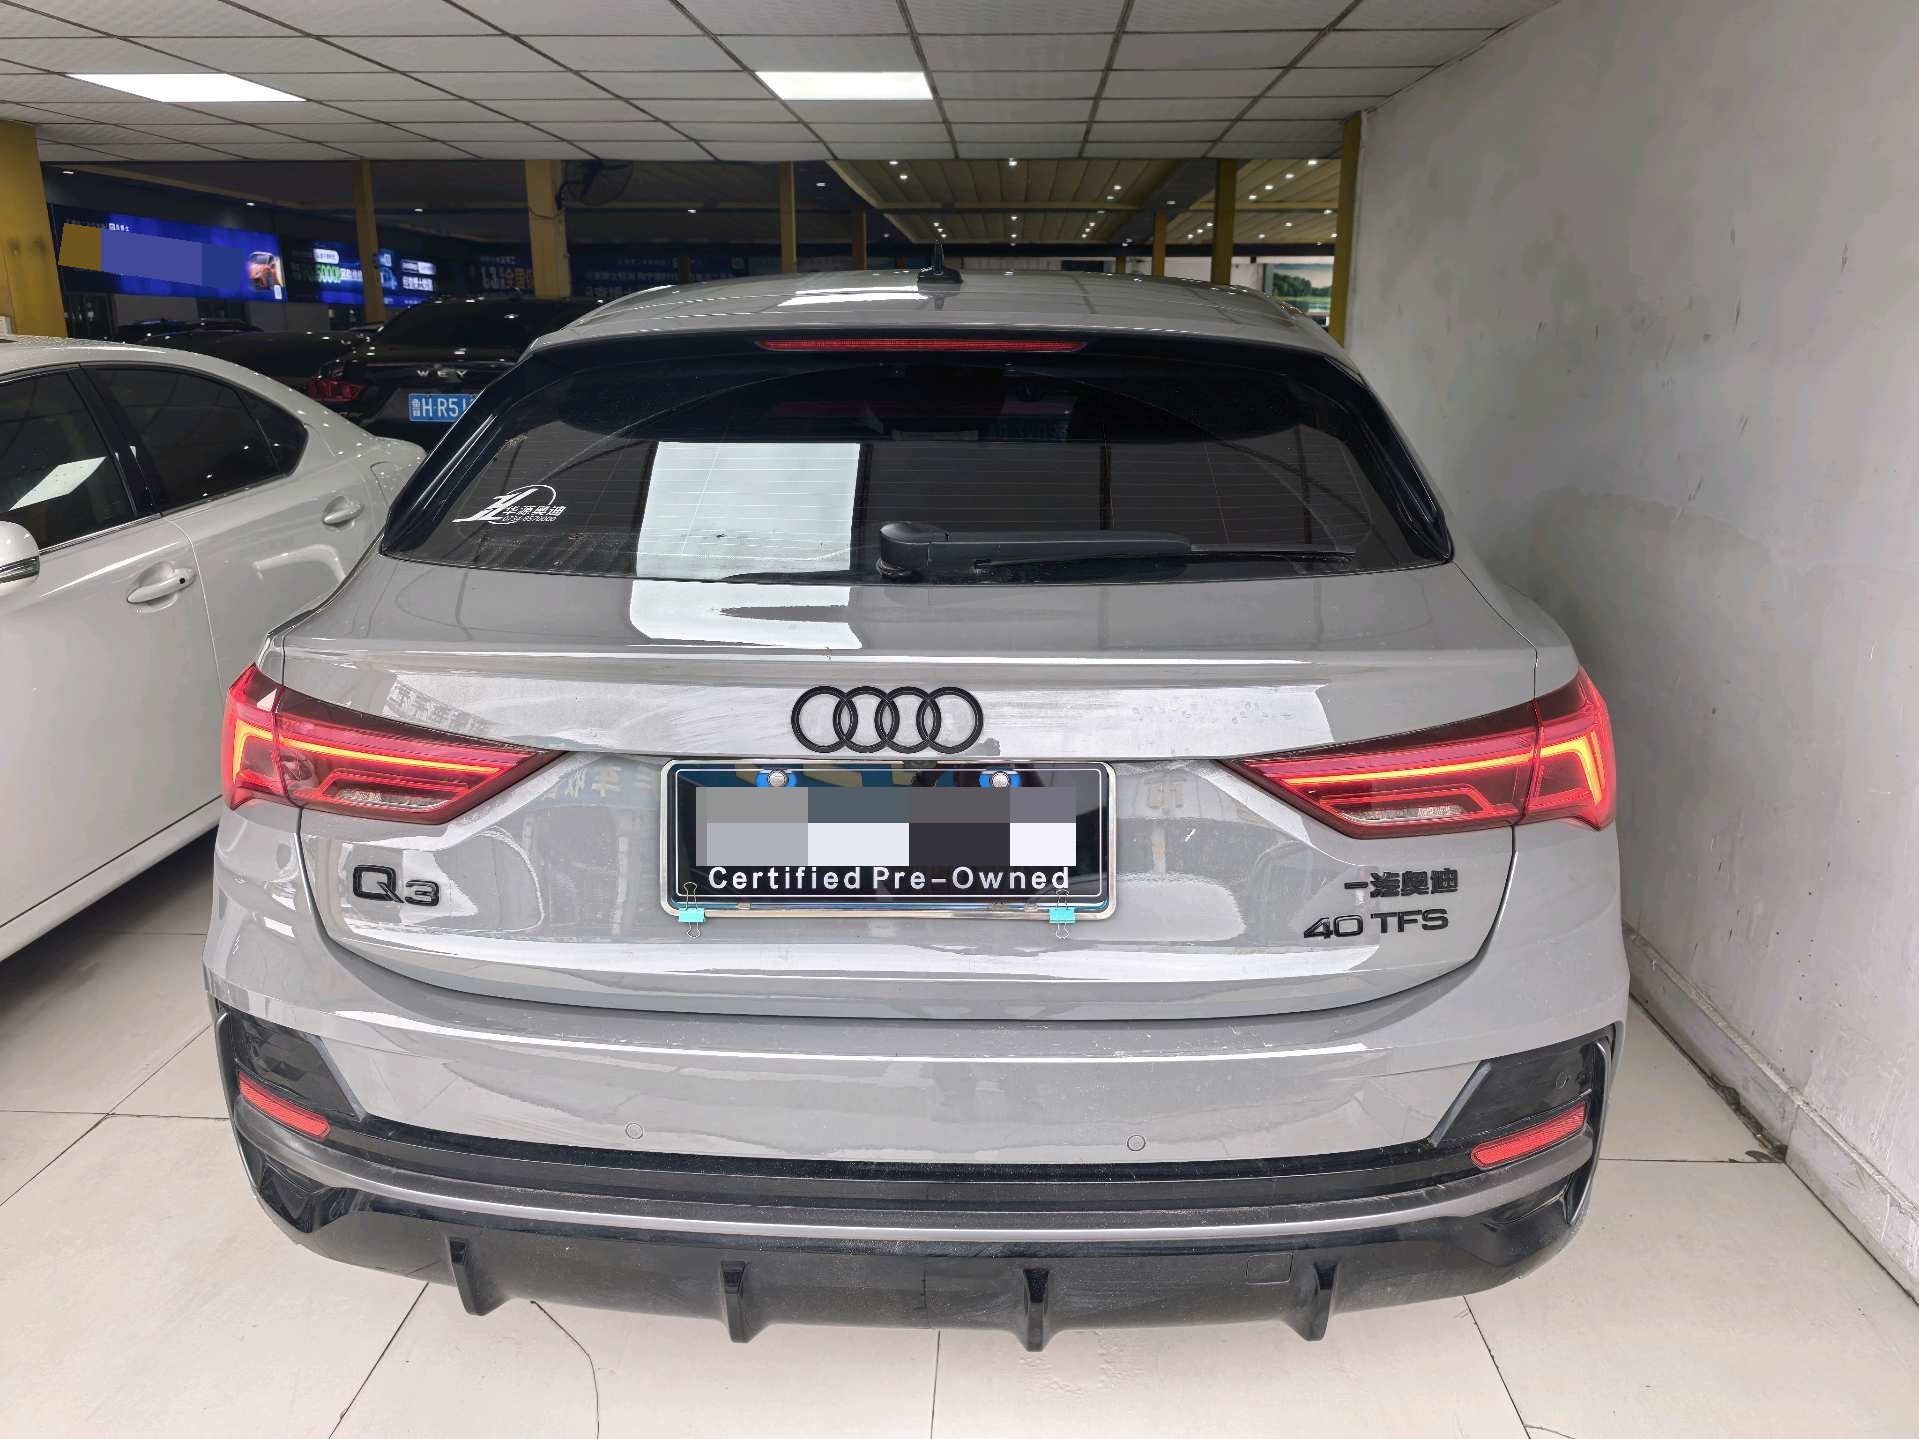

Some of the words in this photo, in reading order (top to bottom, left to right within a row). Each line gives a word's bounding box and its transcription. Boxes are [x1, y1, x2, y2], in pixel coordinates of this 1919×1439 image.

[416, 368, 468, 378] WEY
[352, 864, 440, 906] Q3
[708, 866, 861, 890] Certified
[872, 866, 1069, 890] Pre-Owned
[1303, 914, 1364, 939] 40
[1370, 908, 1449, 934] TFS
